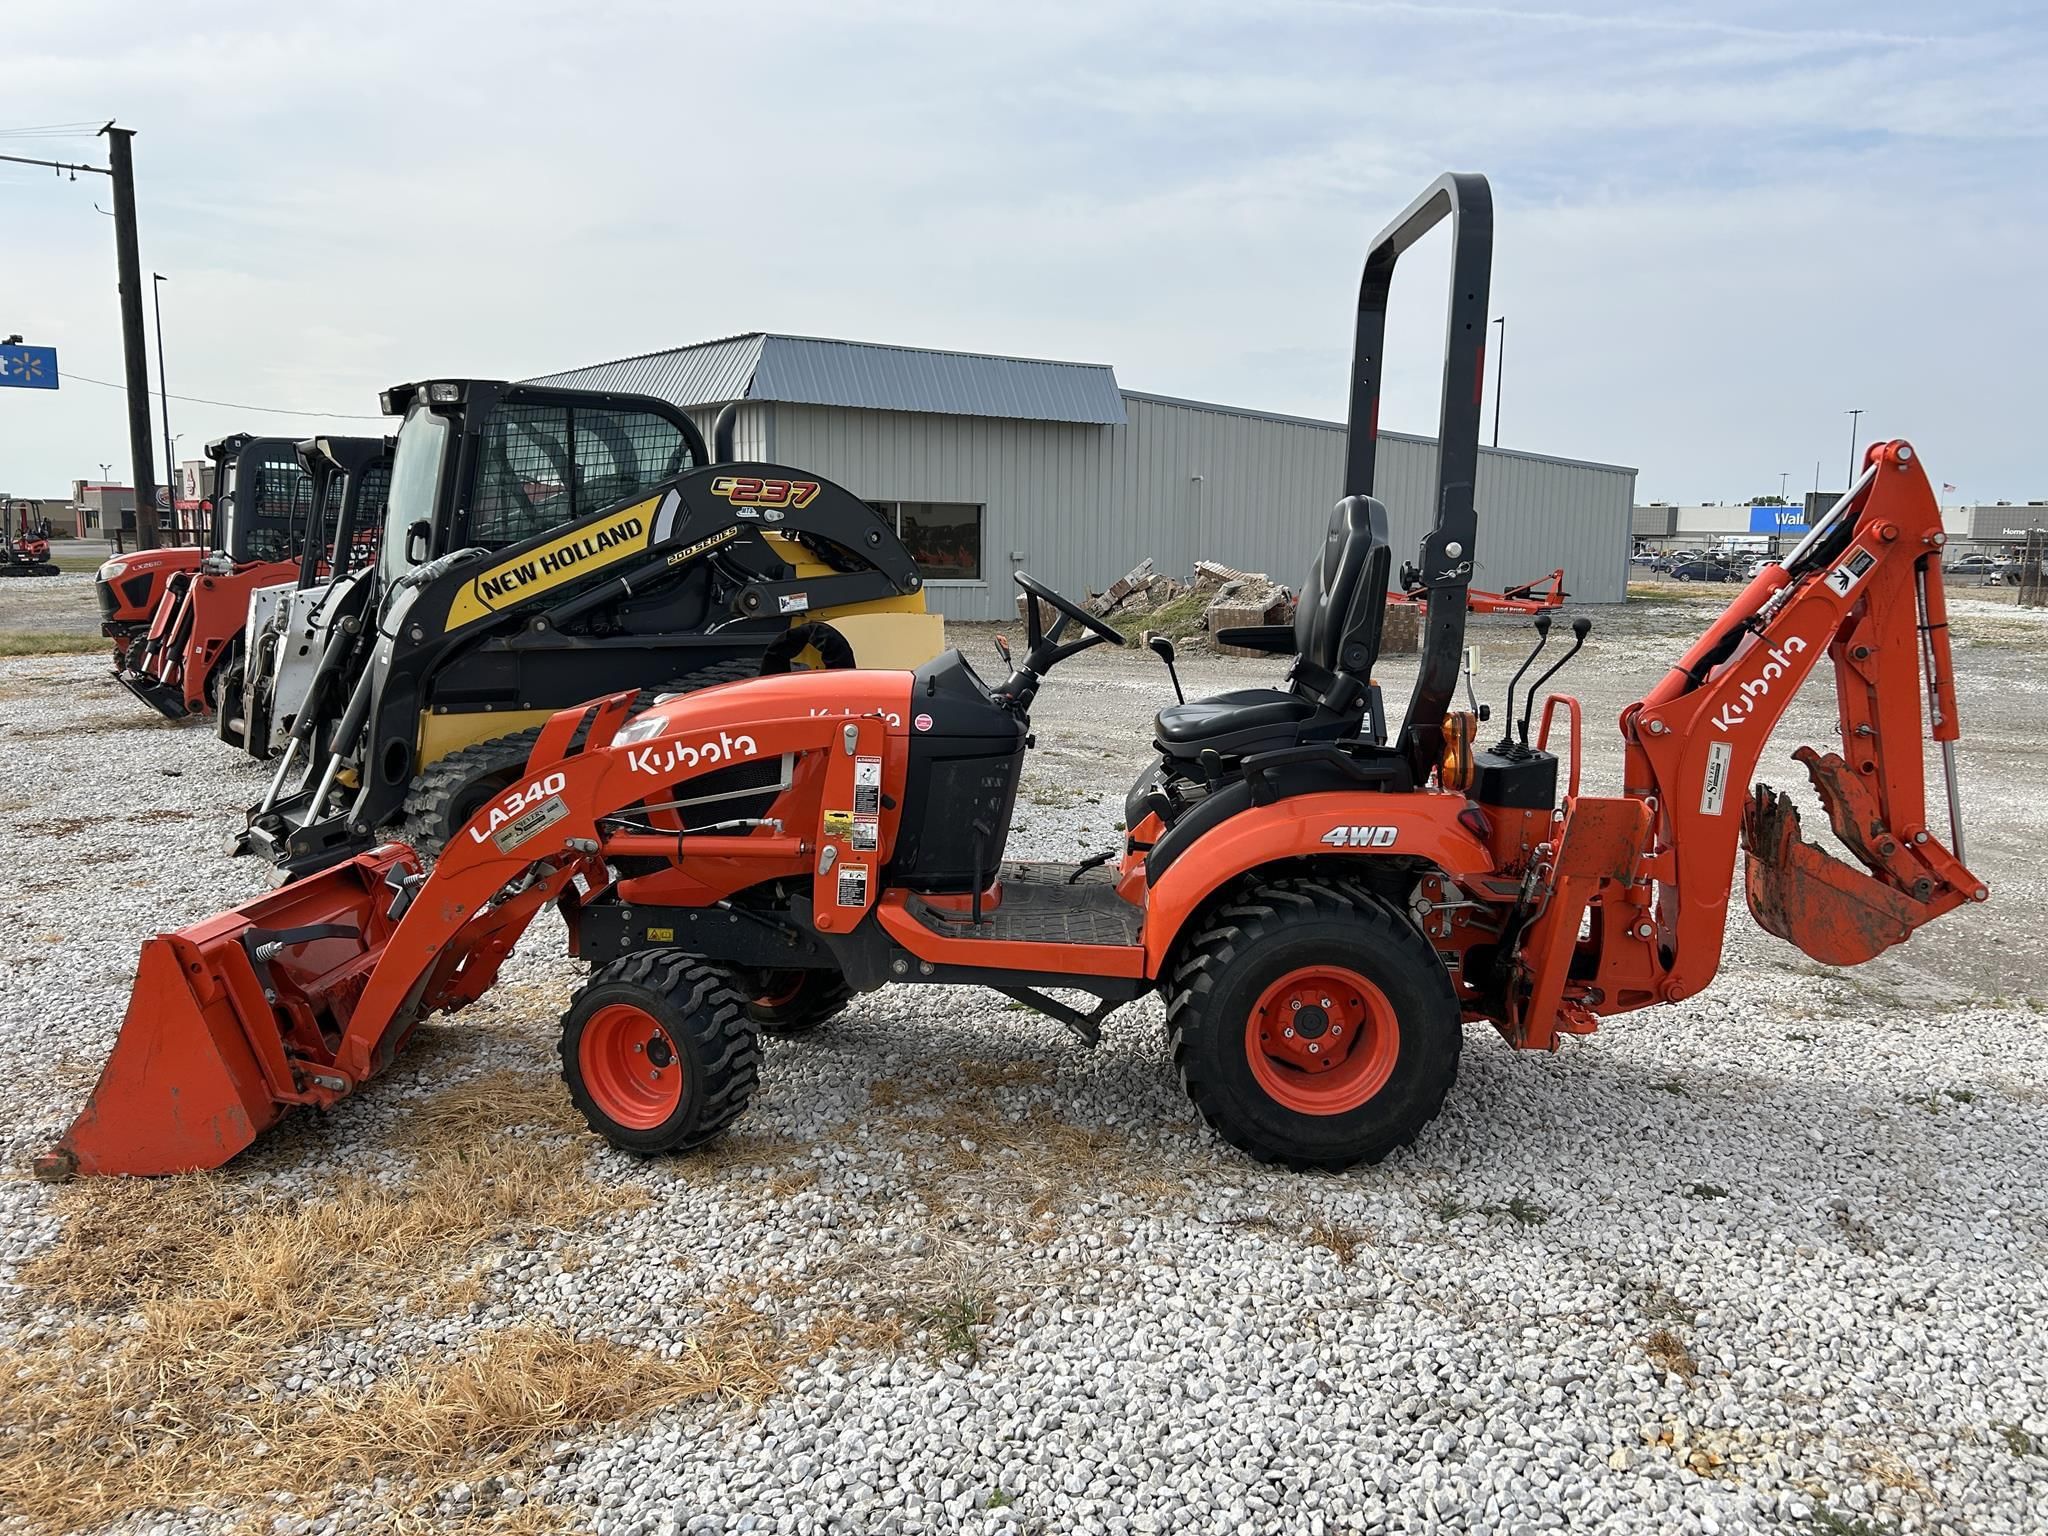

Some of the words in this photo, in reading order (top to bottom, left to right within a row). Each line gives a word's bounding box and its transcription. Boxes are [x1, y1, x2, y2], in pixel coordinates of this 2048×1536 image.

[711, 477, 821, 508] C237
[668, 548, 692, 565] 200
[695, 527, 737, 549] SERIES
[2002, 527, 2025, 535] Home
[132, 560, 162, 570] LX2610
[481, 561, 538, 600] NEW
[540, 517, 643, 575] HOLLAND
[1711, 636, 1807, 732] Kubota
[628, 732, 757, 775] Kubota
[1707, 762, 1717, 795] SIEVERS
[469, 772, 566, 843] LA340
[1320, 825, 1399, 847] 4WD
